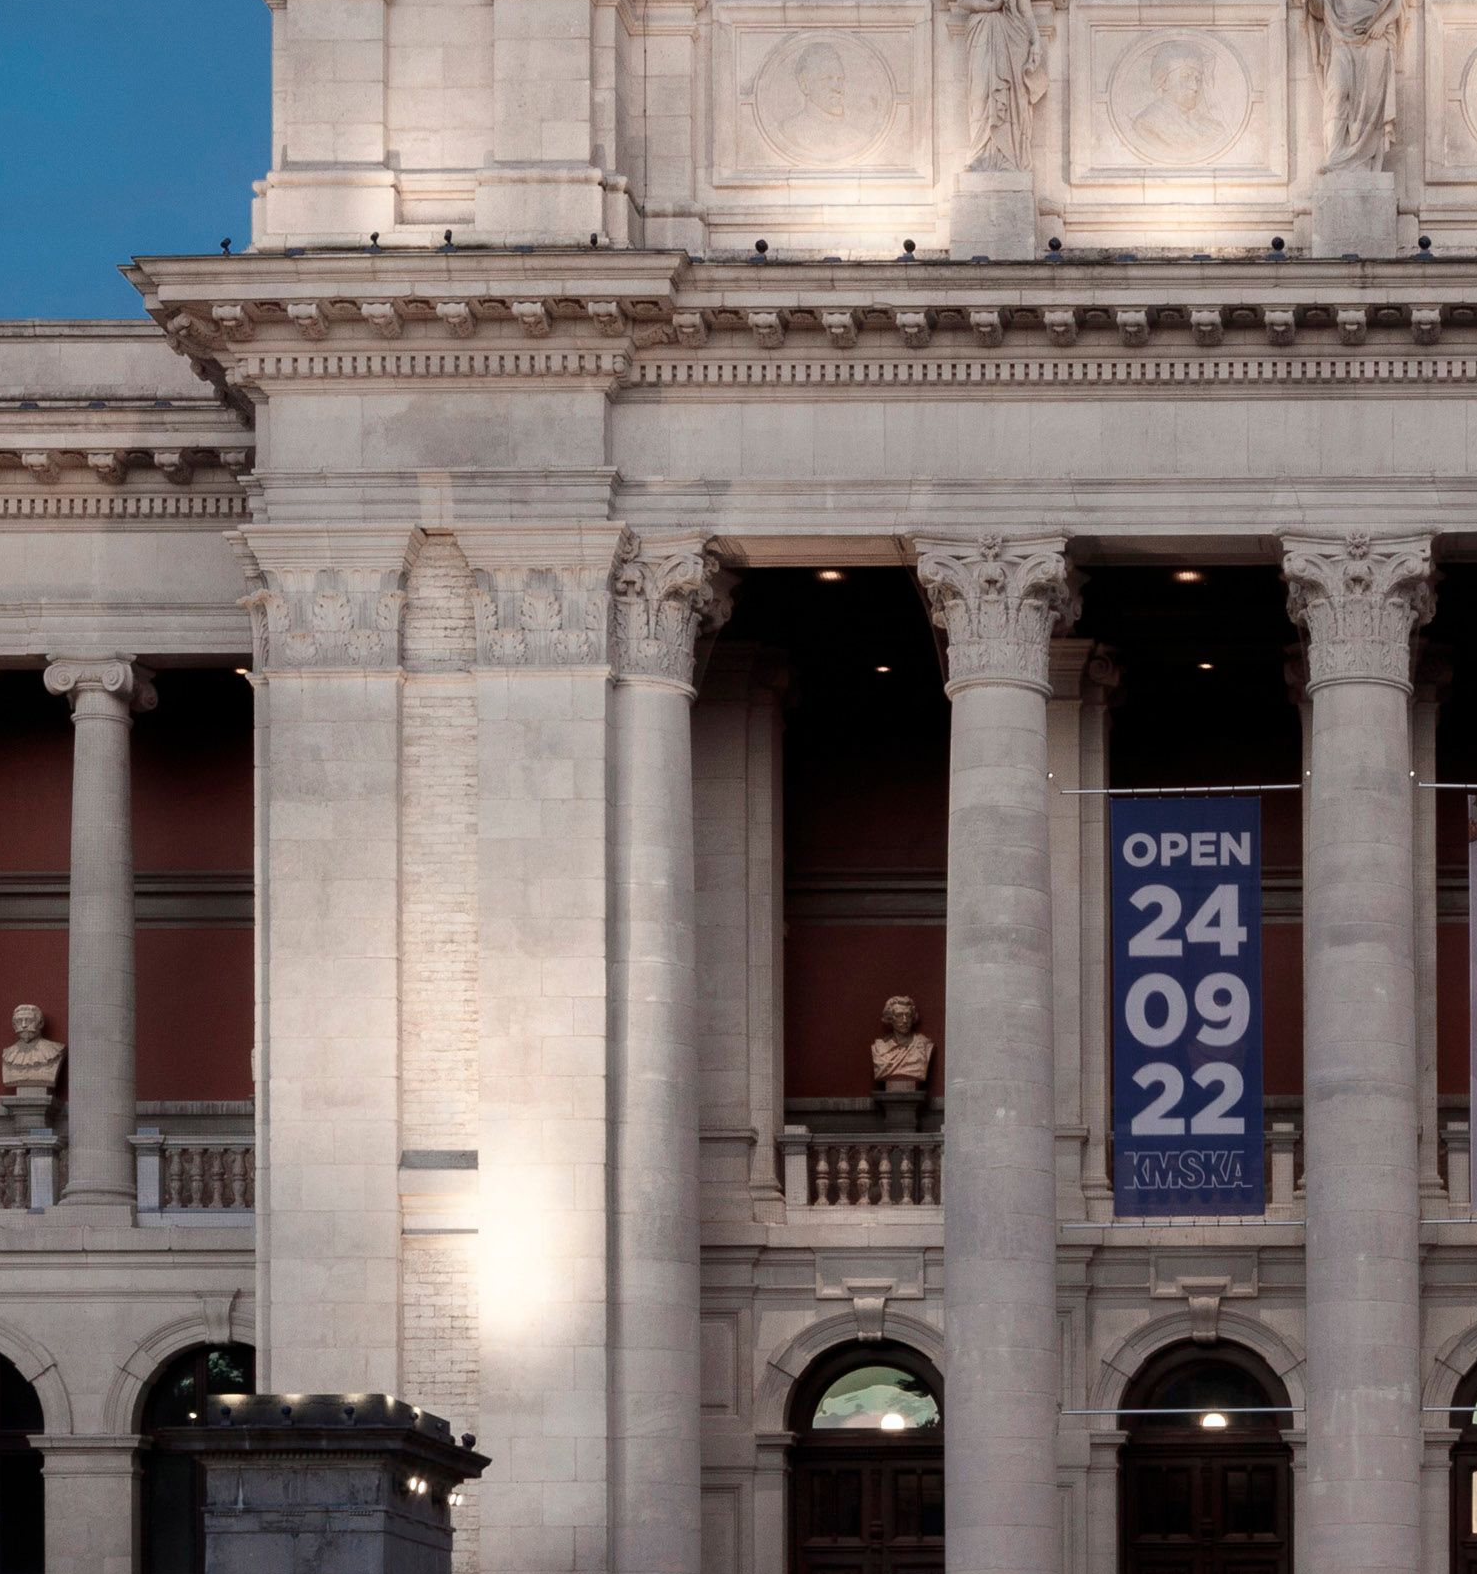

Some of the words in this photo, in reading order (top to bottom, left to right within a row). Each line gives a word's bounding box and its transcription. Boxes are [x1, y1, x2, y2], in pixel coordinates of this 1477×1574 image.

[1123, 832, 1251, 867] OPEN
[1129, 884, 1247, 957] 24
[1125, 972, 1251, 1047] 09
[1131, 1061, 1245, 1135] 22
[1124, 1150, 1253, 1189] KMSKA
